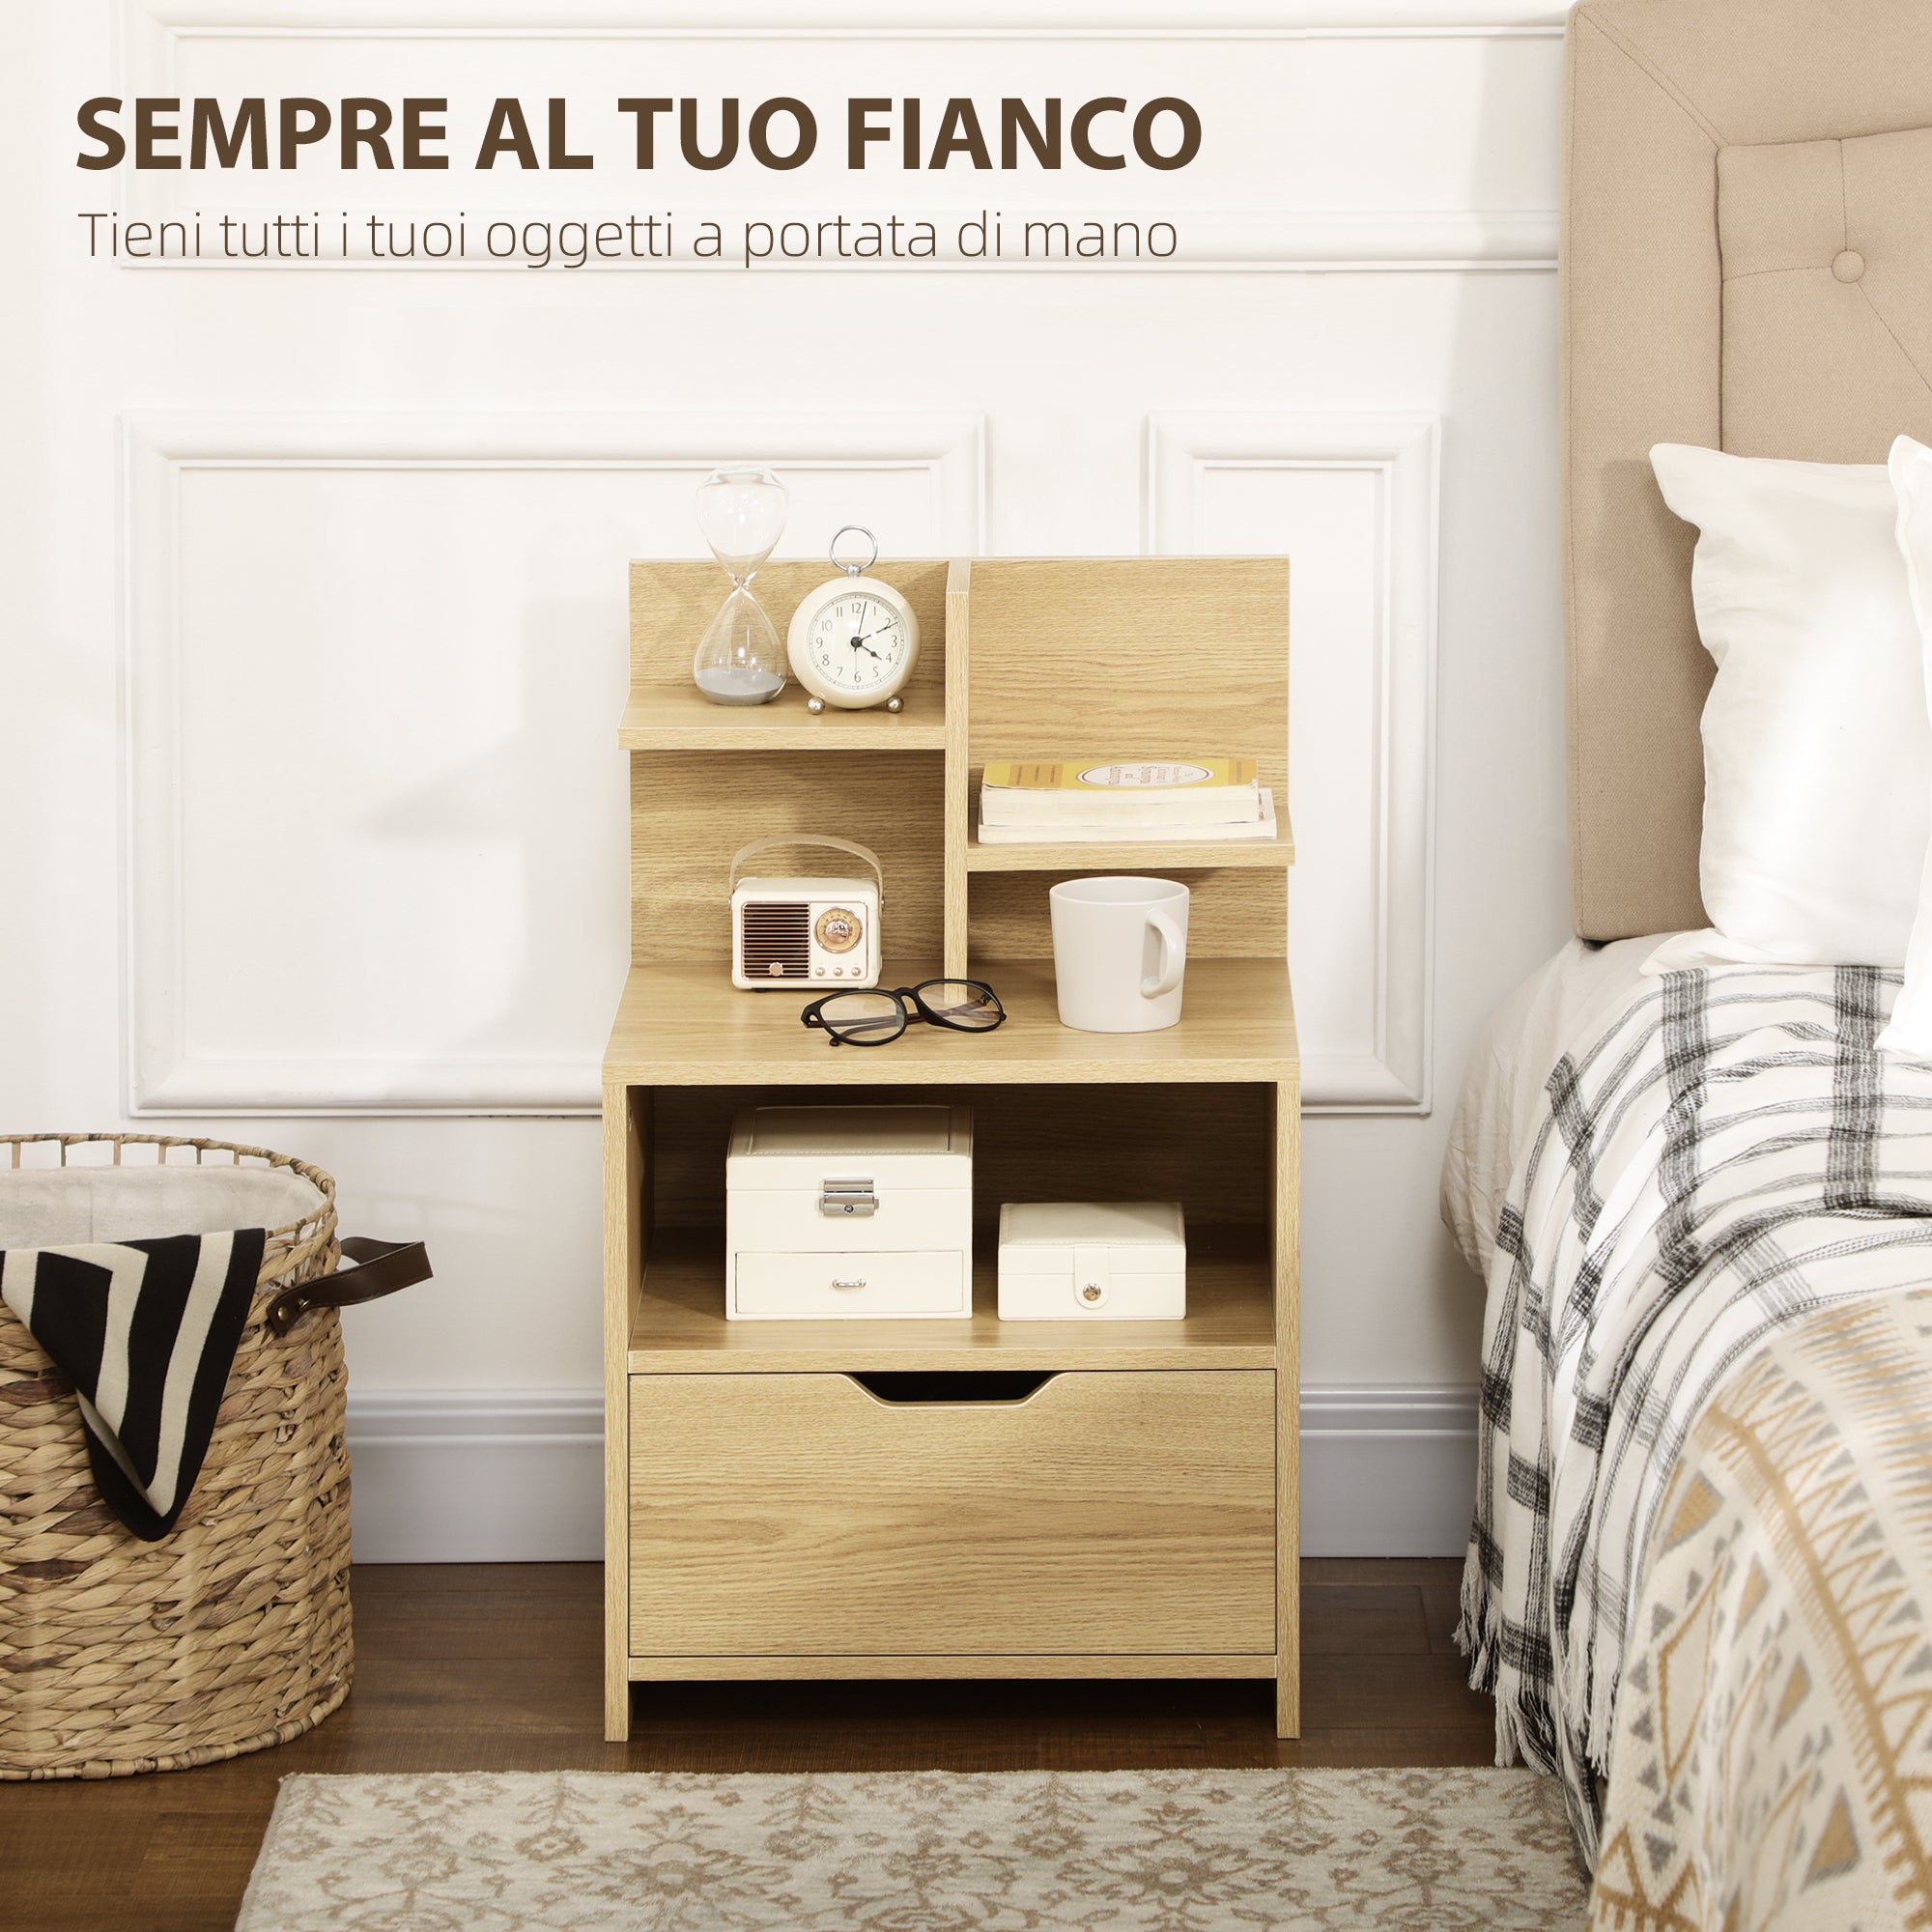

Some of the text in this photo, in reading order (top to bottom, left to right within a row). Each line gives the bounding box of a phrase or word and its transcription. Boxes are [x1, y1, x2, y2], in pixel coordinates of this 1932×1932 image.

[836, 607, 843, 617] 11
[851, 602, 862, 613] 12
[821, 620, 833, 631] 10
[884, 617, 892, 629] 2
[816, 637, 823, 648] 9
[891, 635, 897, 647] 3
[822, 654, 830, 667] 8
[885, 653, 892, 664] 4
[837, 667, 843, 677] 7
[854, 671, 862, 683] 6
[872, 667, 879, 678] 5
